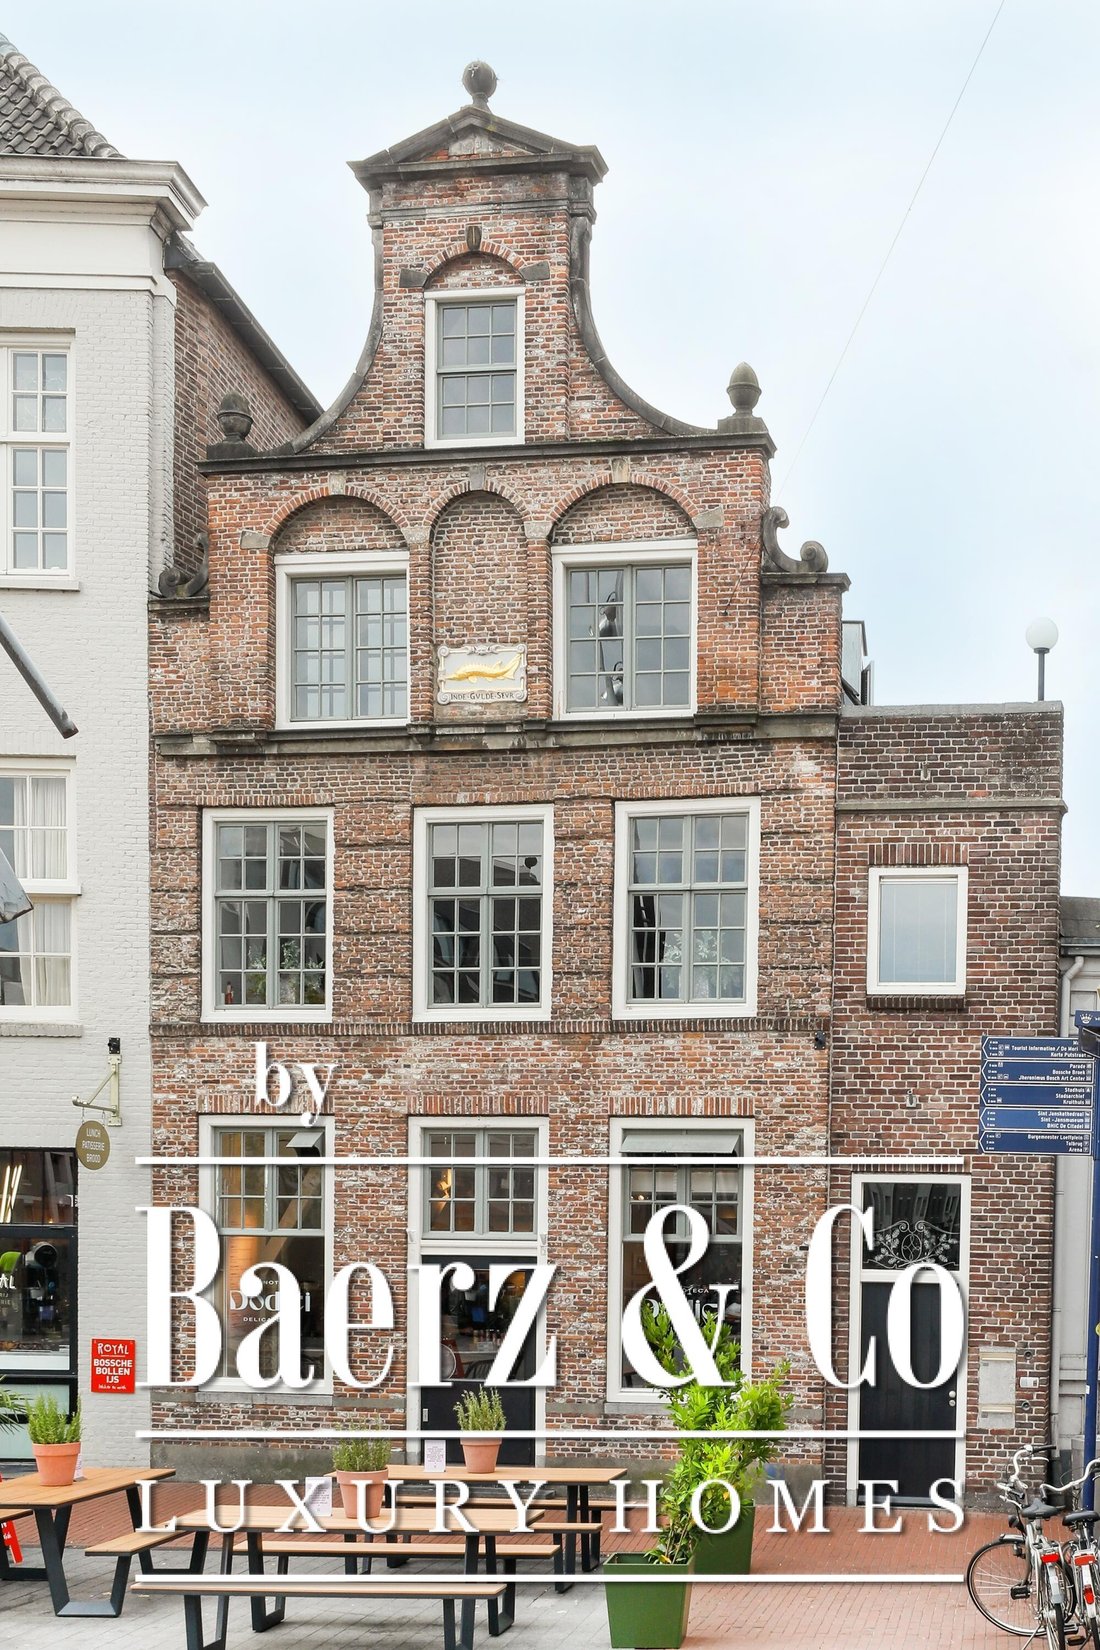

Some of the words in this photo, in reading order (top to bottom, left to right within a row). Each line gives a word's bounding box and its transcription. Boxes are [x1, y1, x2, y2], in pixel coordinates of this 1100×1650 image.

[97, 1342, 129, 1355] ROYAL
[93, 1358, 133, 1368] BOSSCHE
[95, 1366, 131, 1376] BOLLEN
[106, 1375, 120, 1384] IJS
